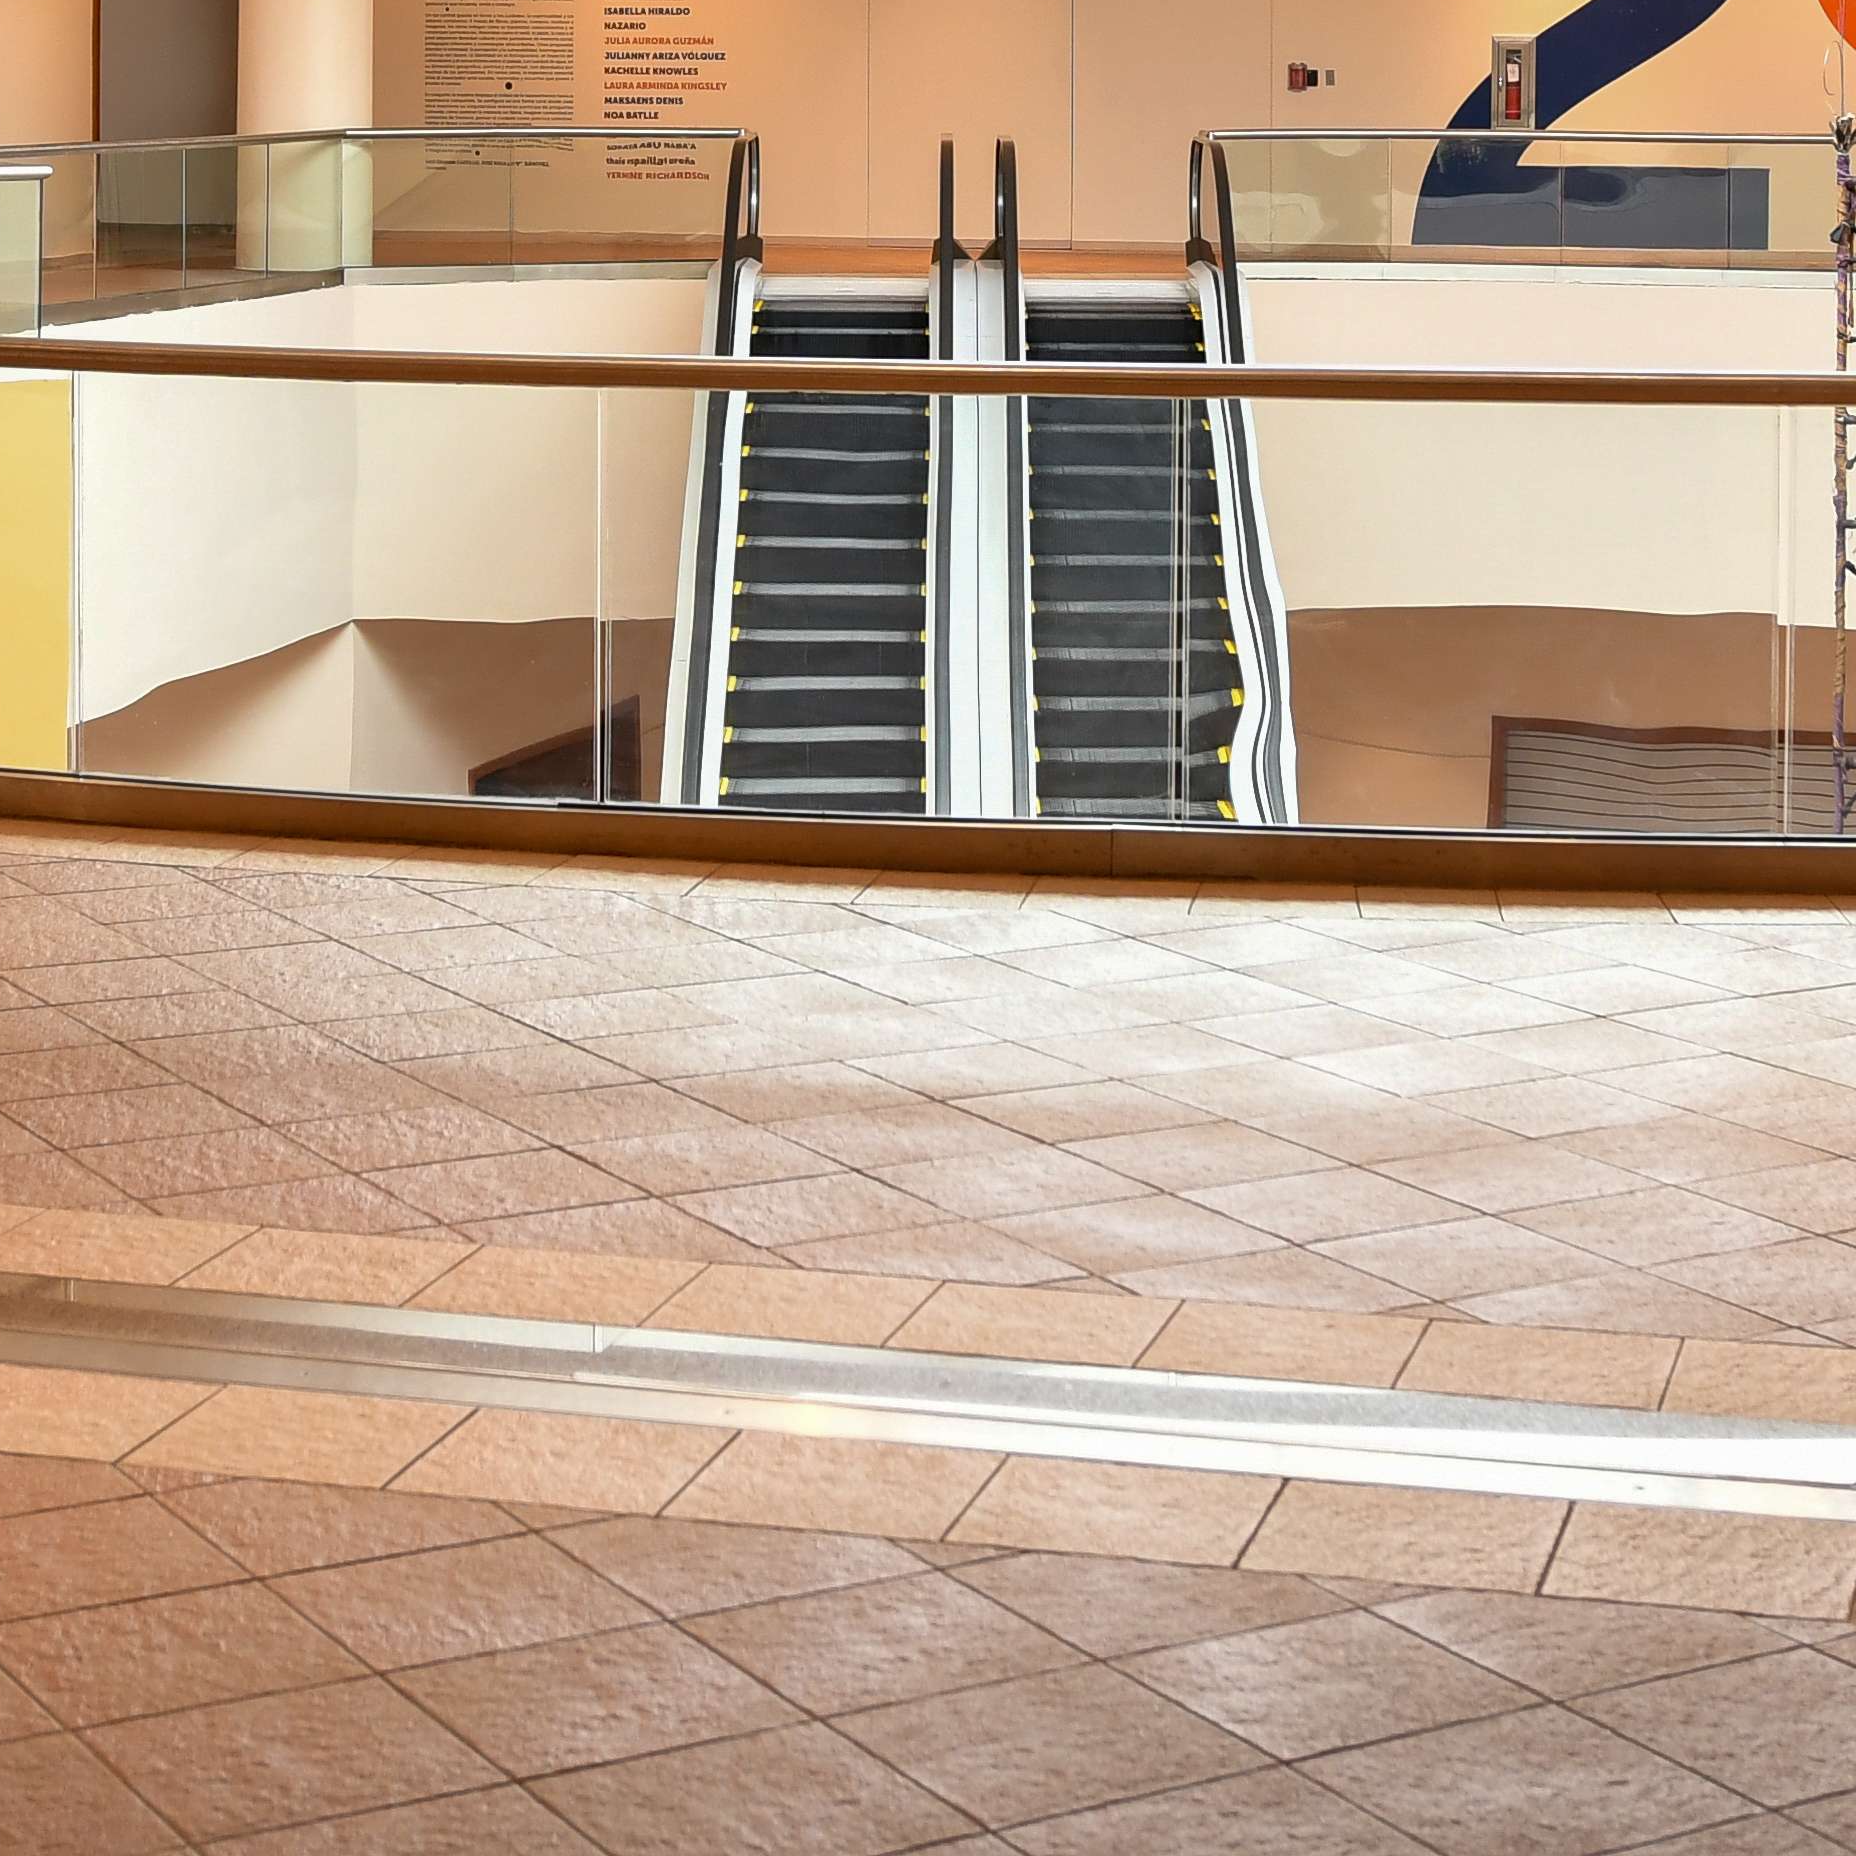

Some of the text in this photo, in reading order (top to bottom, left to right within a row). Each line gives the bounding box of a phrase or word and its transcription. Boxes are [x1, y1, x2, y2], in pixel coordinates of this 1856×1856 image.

[604, 8, 690, 16] ISABELLA HIRALDO
[604, 22, 646, 31] NAZARIO
[605, 35, 714, 46] JULIA AURORA GUZMÁN
[605, 52, 651, 61] JULIANNY
[652, 52, 680, 61] ARIZA
[604, 67, 698, 76] KACHELLE KNOWLES
[604, 82, 727, 91] LAURA ARMINDA KINGSLEY
[656, 97, 684, 105] DENIS
[604, 112, 624, 120] NOA
